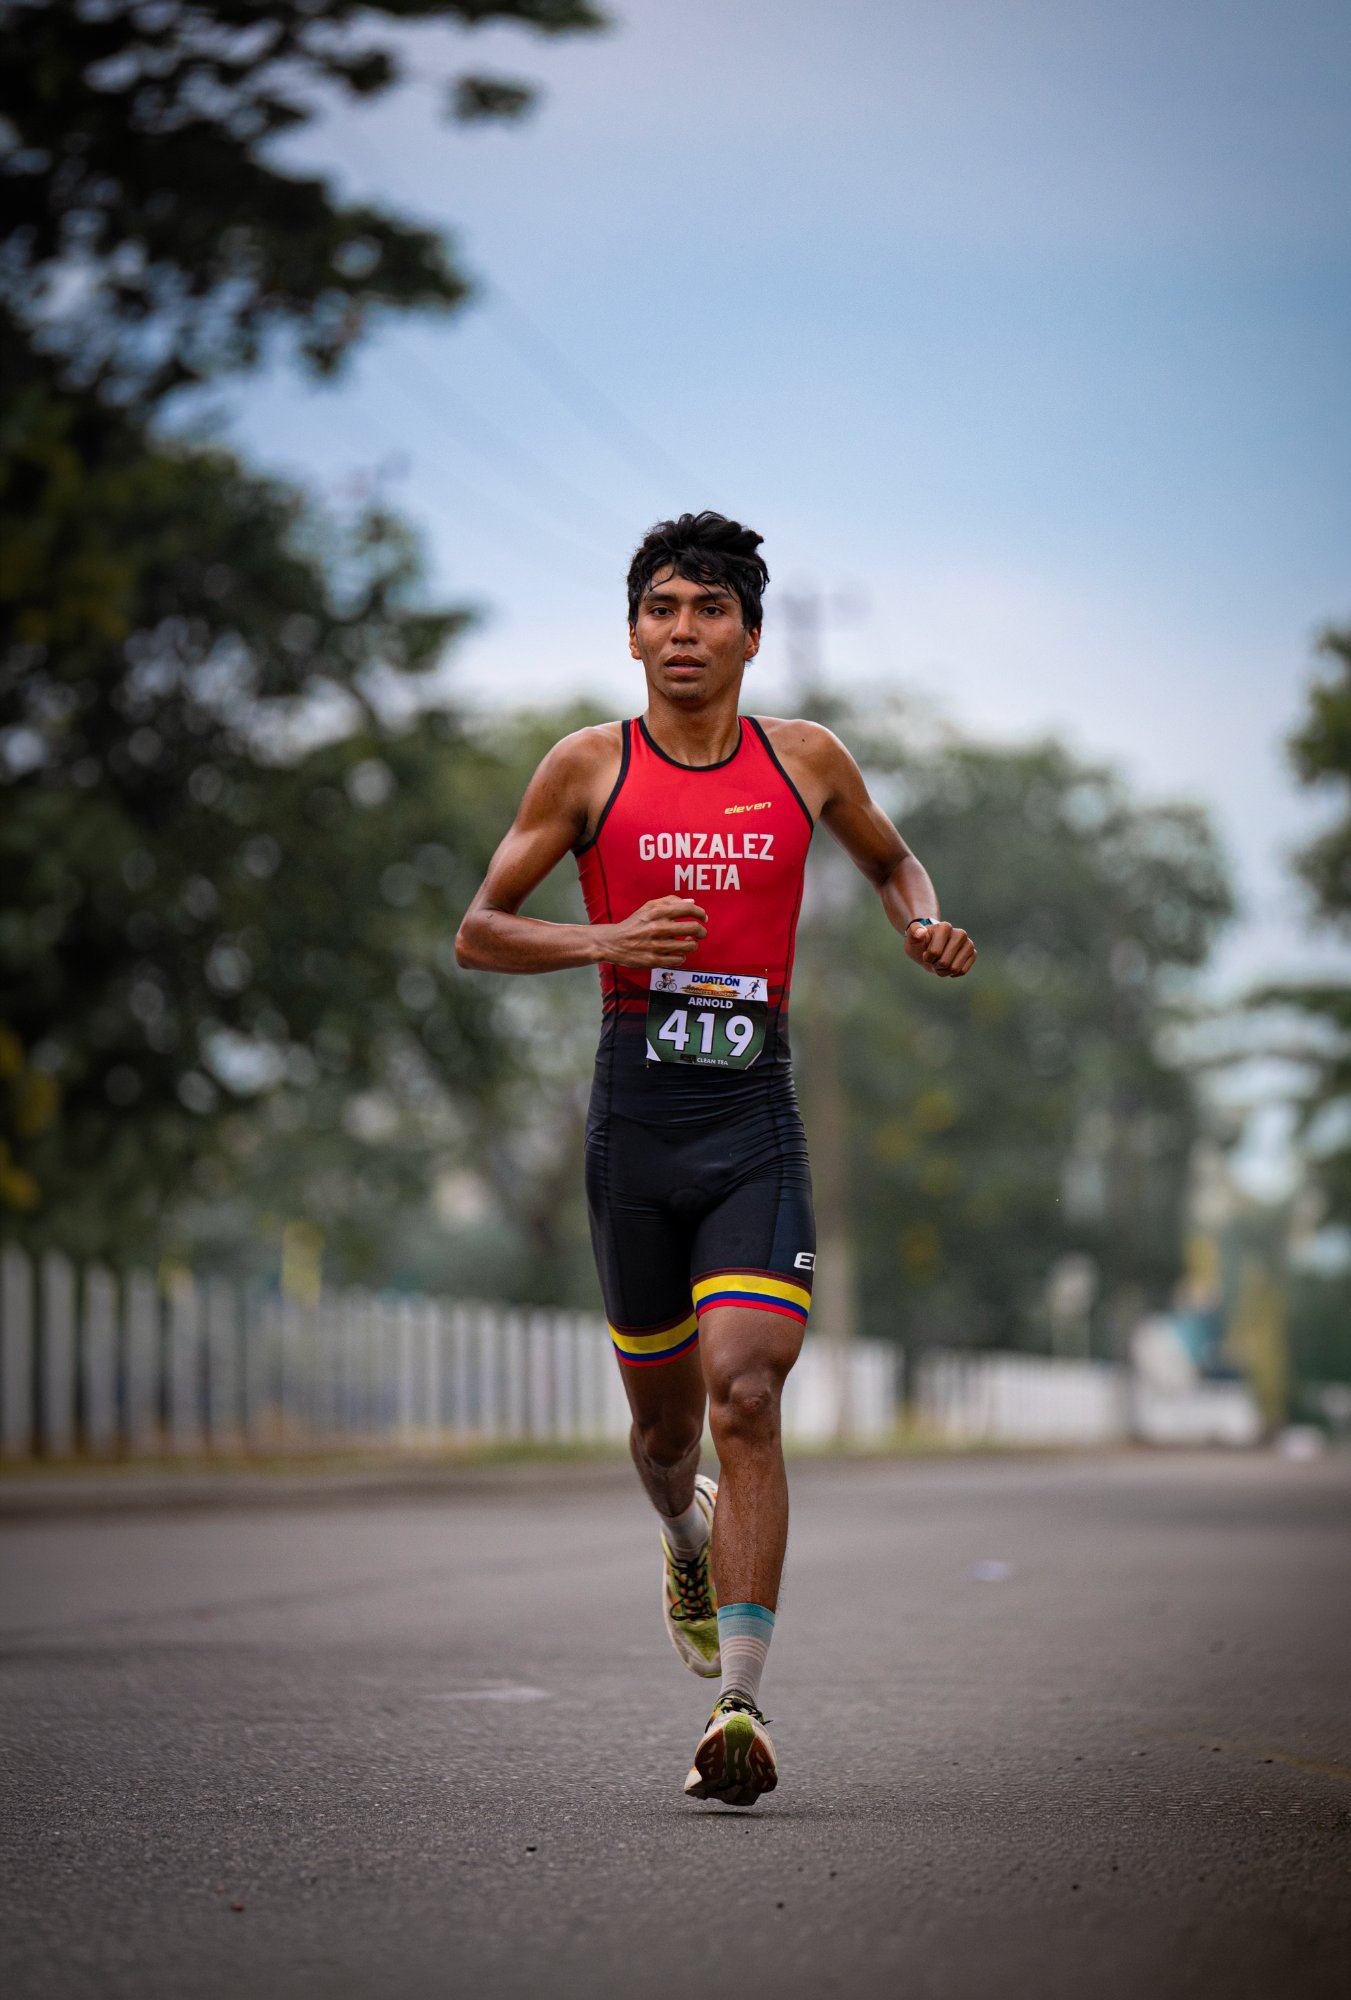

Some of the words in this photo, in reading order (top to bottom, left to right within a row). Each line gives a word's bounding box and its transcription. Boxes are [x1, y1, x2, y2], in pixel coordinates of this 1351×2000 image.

[724, 801, 772, 815] eleven
[639, 832, 775, 861] GONZALEZ
[674, 864, 741, 891] META
[691, 975, 740, 987] DUATLÓN
[688, 996, 734, 1009] ARNOLD
[658, 1009, 754, 1057] 419
[696, 1057, 716, 1065] CLEAN
